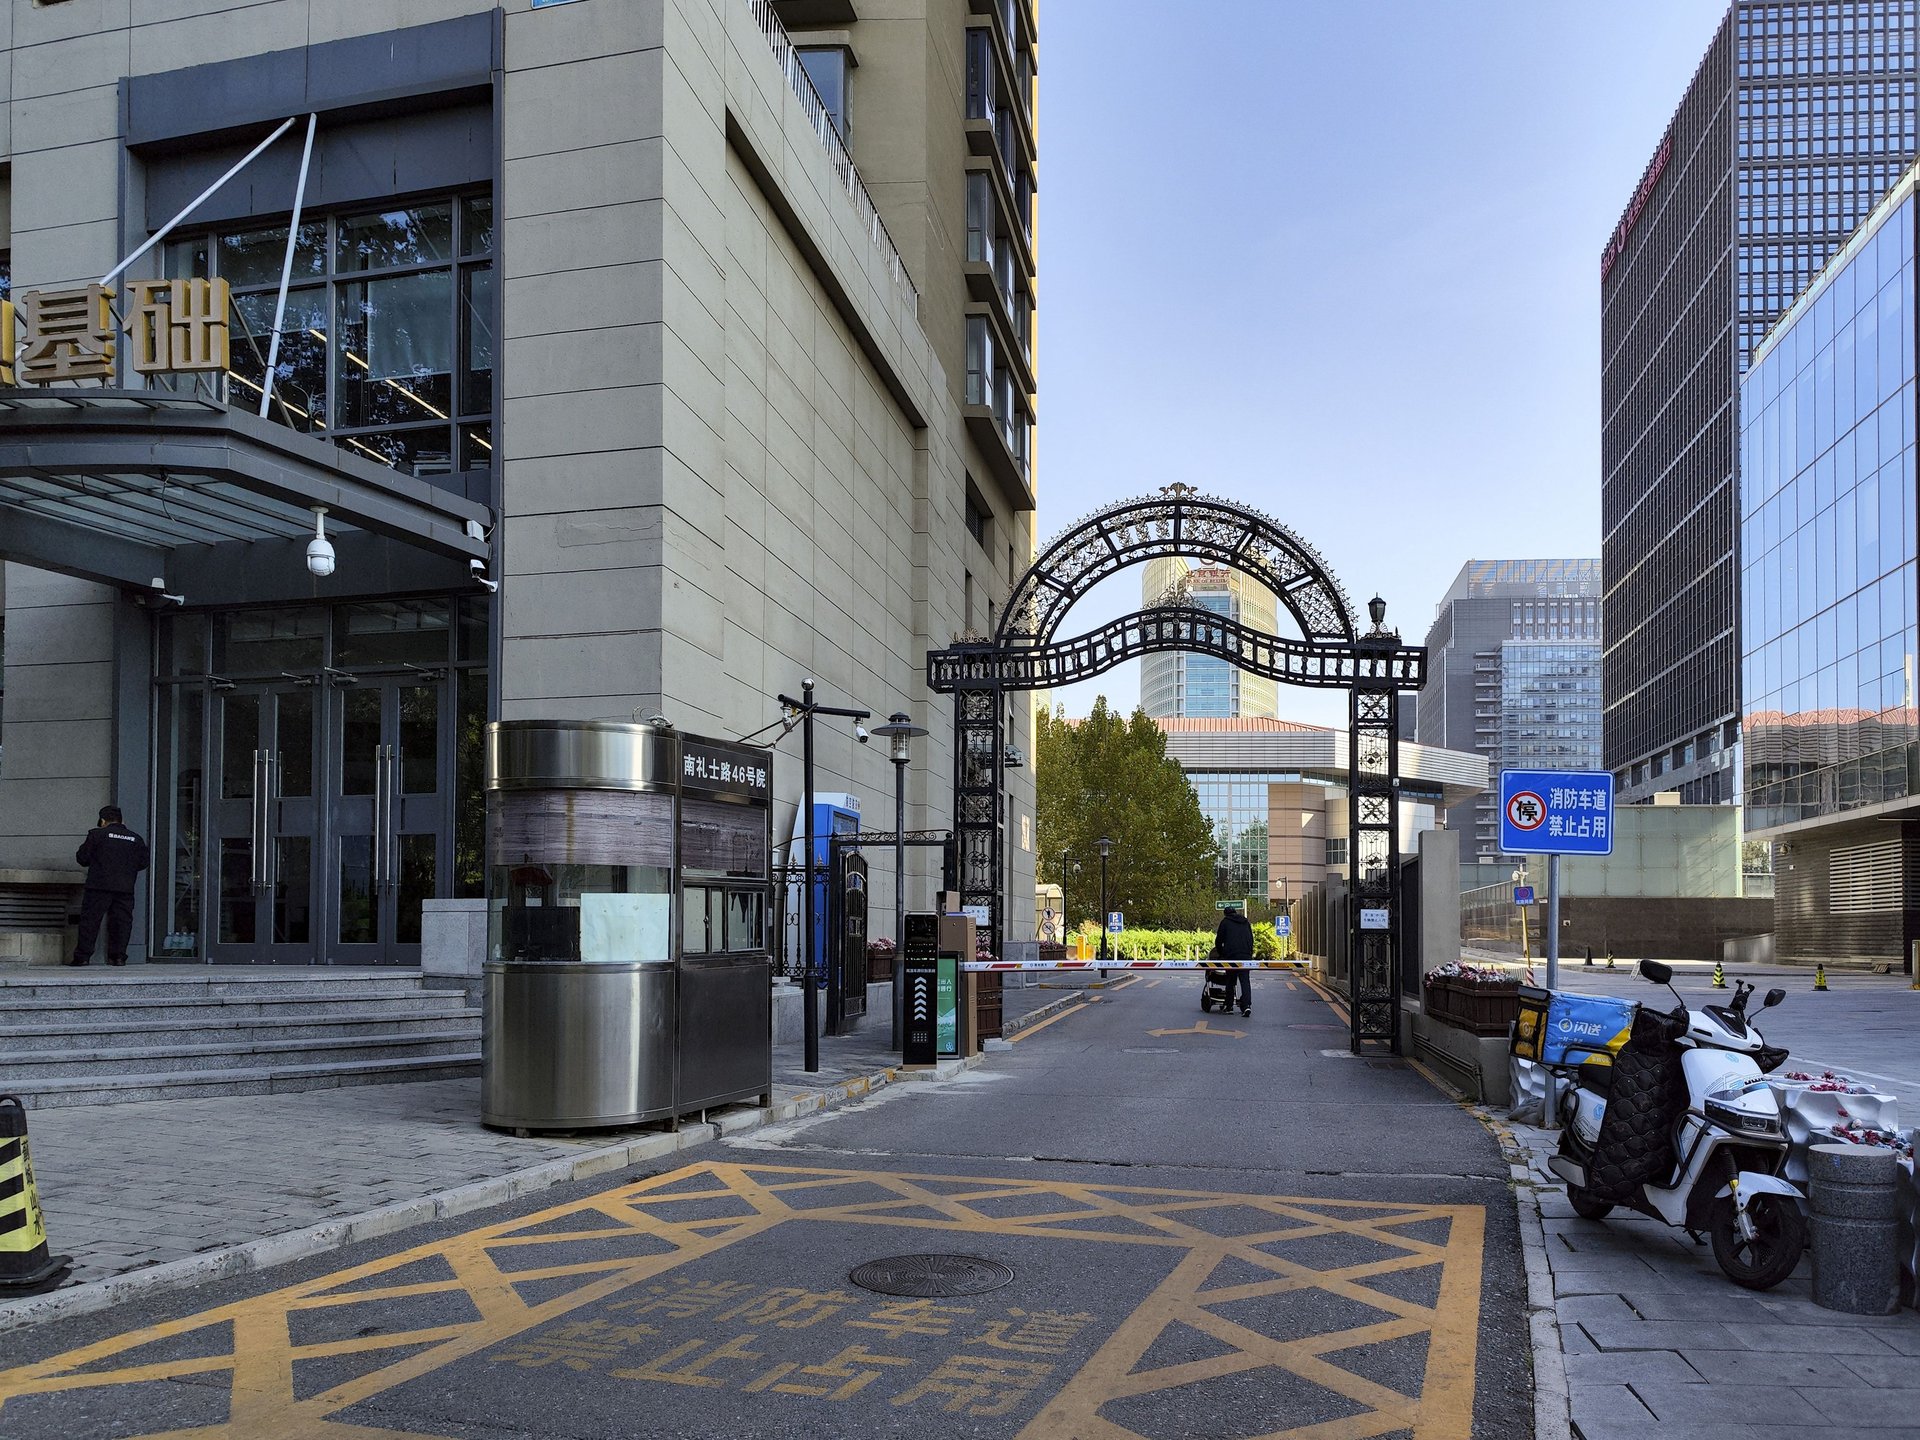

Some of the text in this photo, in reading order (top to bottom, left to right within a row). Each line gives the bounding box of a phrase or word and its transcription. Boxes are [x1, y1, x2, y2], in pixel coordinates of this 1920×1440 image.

[0, 276, 230, 385] 基础
[683, 753, 766, 788] 南礼士路46号院
[1550, 787, 1607, 811] 消防车道
[1516, 800, 1538, 822] 停
[1549, 815, 1606, 838] 禁止占用
[1112, 913, 1119, 923] P
[1279, 917, 1286, 926] P
[1573, 1021, 1602, 1036] 闪送
[608, 1279, 1096, 1353] 消防车道
[491, 1320, 1055, 1415] 禁止占用
